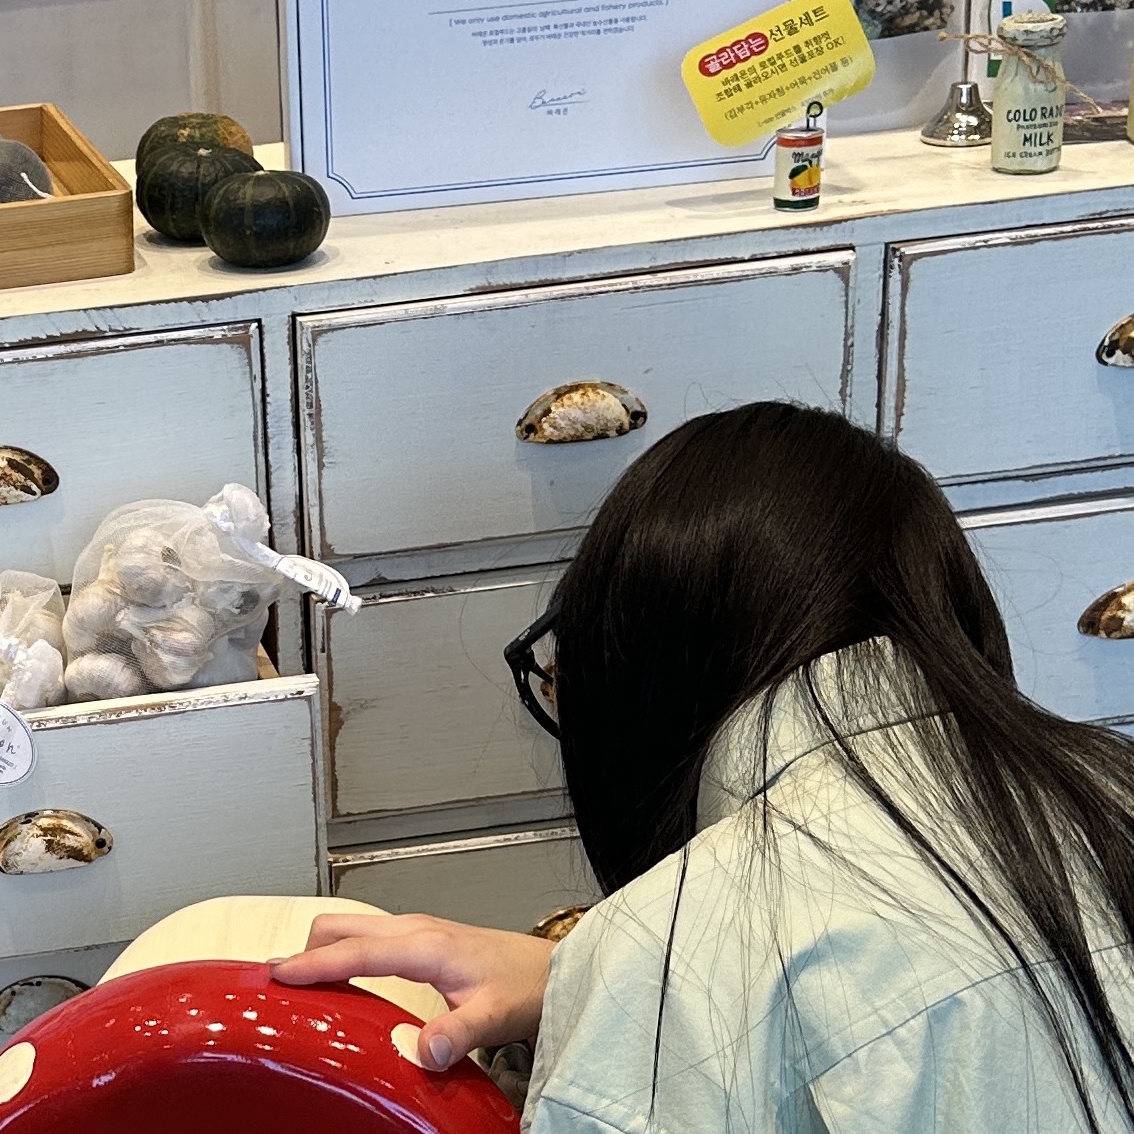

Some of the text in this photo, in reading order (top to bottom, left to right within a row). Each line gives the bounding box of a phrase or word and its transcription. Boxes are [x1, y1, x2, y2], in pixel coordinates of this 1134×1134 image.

[705, 5, 829, 74] 골라담는 선물세트
[1022, 130, 1054, 147] MILK
